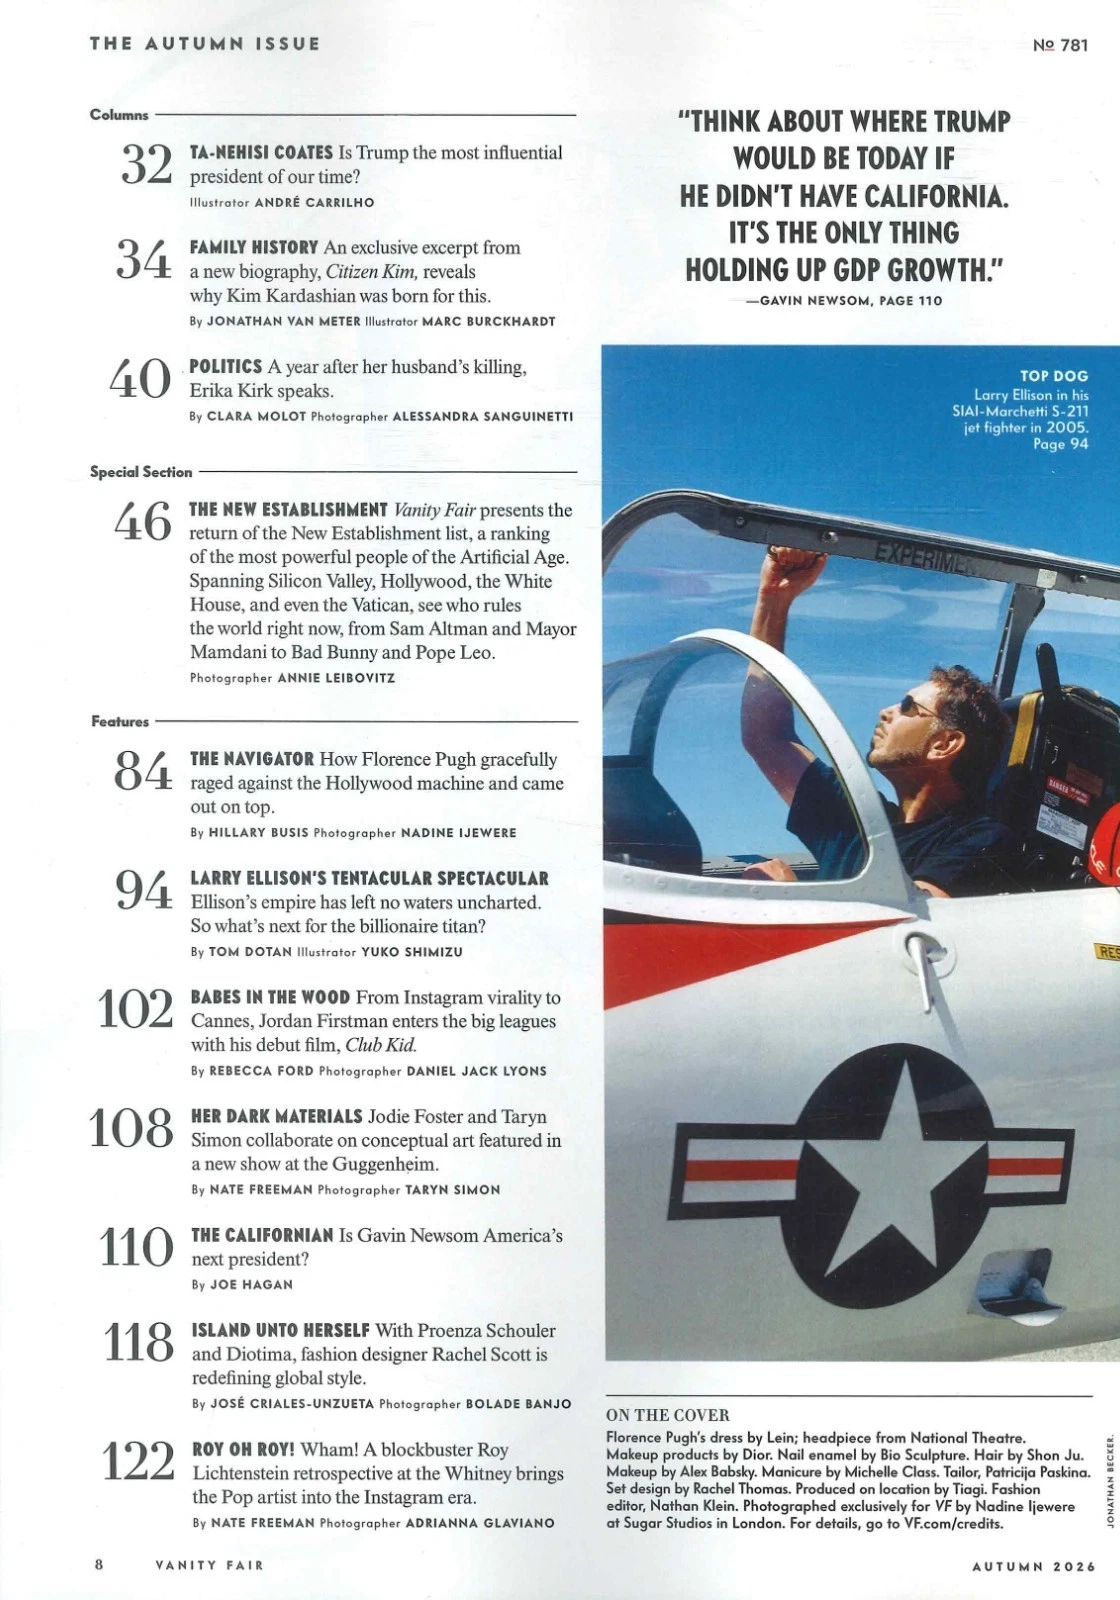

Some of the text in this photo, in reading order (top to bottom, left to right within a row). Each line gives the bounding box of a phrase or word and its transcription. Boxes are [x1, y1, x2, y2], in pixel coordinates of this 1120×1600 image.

[89, 36, 319, 52] THE AUTUMN ISSUE
[1060, 38, 1088, 53] 781
[89, 107, 150, 121] Columns
[678, 109, 1012, 134] “THINK ABOUT WHERE TRUMP
[189, 144, 563, 164] TA-NEHISI COATES Is Trump the most influential
[732, 145, 955, 171] WOULD BE TODAY IF
[121, 143, 172, 185] 32
[190, 195, 375, 208] Illustrator ANDRÉ CARRILHO
[680, 183, 1010, 209] HE DIDN’T HAVE CALIFORNIA.
[729, 219, 960, 245] IT’S THE ONLY THING
[116, 238, 172, 280] 34
[686, 256, 1004, 283] HOLDING UP GDP GROWTH.”
[807, 295, 874, 308] NEWSOM,
[879, 295, 914, 307] PAGE
[918, 295, 943, 307] 110
[189, 315, 556, 329] By JONATHAN VAN METER Illustrator MARC BURCKHARDT
[189, 358, 527, 378] POLITICS A year after her husband’s killing,
[1019, 369, 1089, 383] TOP DOG
[109, 357, 171, 399] 40
[974, 388, 1090, 404] Larry Ellison in his
[189, 410, 574, 425] By CLARA MOLOT Photographer ALESSANDRA SANGUINETTI
[952, 404, 1089, 418] SIAI-Marchetti S-211
[964, 420, 1089, 437] jet fighter in 2005.
[1033, 437, 1089, 454] Page 94
[89, 464, 193, 482] Special Section
[188, 501, 573, 522] THE NEW ESTABLISHMENT Vanity Fair presents the
[113, 500, 172, 542] 46
[190, 672, 396, 686] Photographer ANNIE LEIBOVITZ
[91, 714, 150, 728] Features
[114, 750, 173, 791] 84
[190, 870, 549, 887] LARRY ELLISON'S TENTACULAR SPECTACULAR
[115, 869, 173, 911] 94
[191, 946, 463, 960] By TOM DOTAN Illustrator YUKO SHIMIZU
[98, 988, 173, 1029] 102
[89, 1107, 174, 1149] 108
[99, 1226, 174, 1268] 110
[191, 1278, 293, 1293] By JOE HAGAN
[104, 1321, 174, 1363] 118
[192, 1395, 572, 1412] By JOSÉ CRIALES-UNZUETA Photographer BOLADE BANJO
[605, 1408, 731, 1422] ON THE COVER
[606, 1430, 1027, 1448] Florence Pugh’s dress by Lein; headpiece from National Theatre.
[192, 1441, 509, 1461] ROY OH ROY! Wham! A blockbuster Roy
[102, 1440, 175, 1481] 122
[1106, 1434, 1115, 1529] JONATHAN BECKER.
[606, 1515, 1004, 1533] at Sugar Studios in London. For details, go to VF.com/credits.
[94, 1558, 104, 1571] 8
[155, 1559, 263, 1571] VANITY FAIR
[971, 1561, 1096, 1572] AUTUMN 2026
